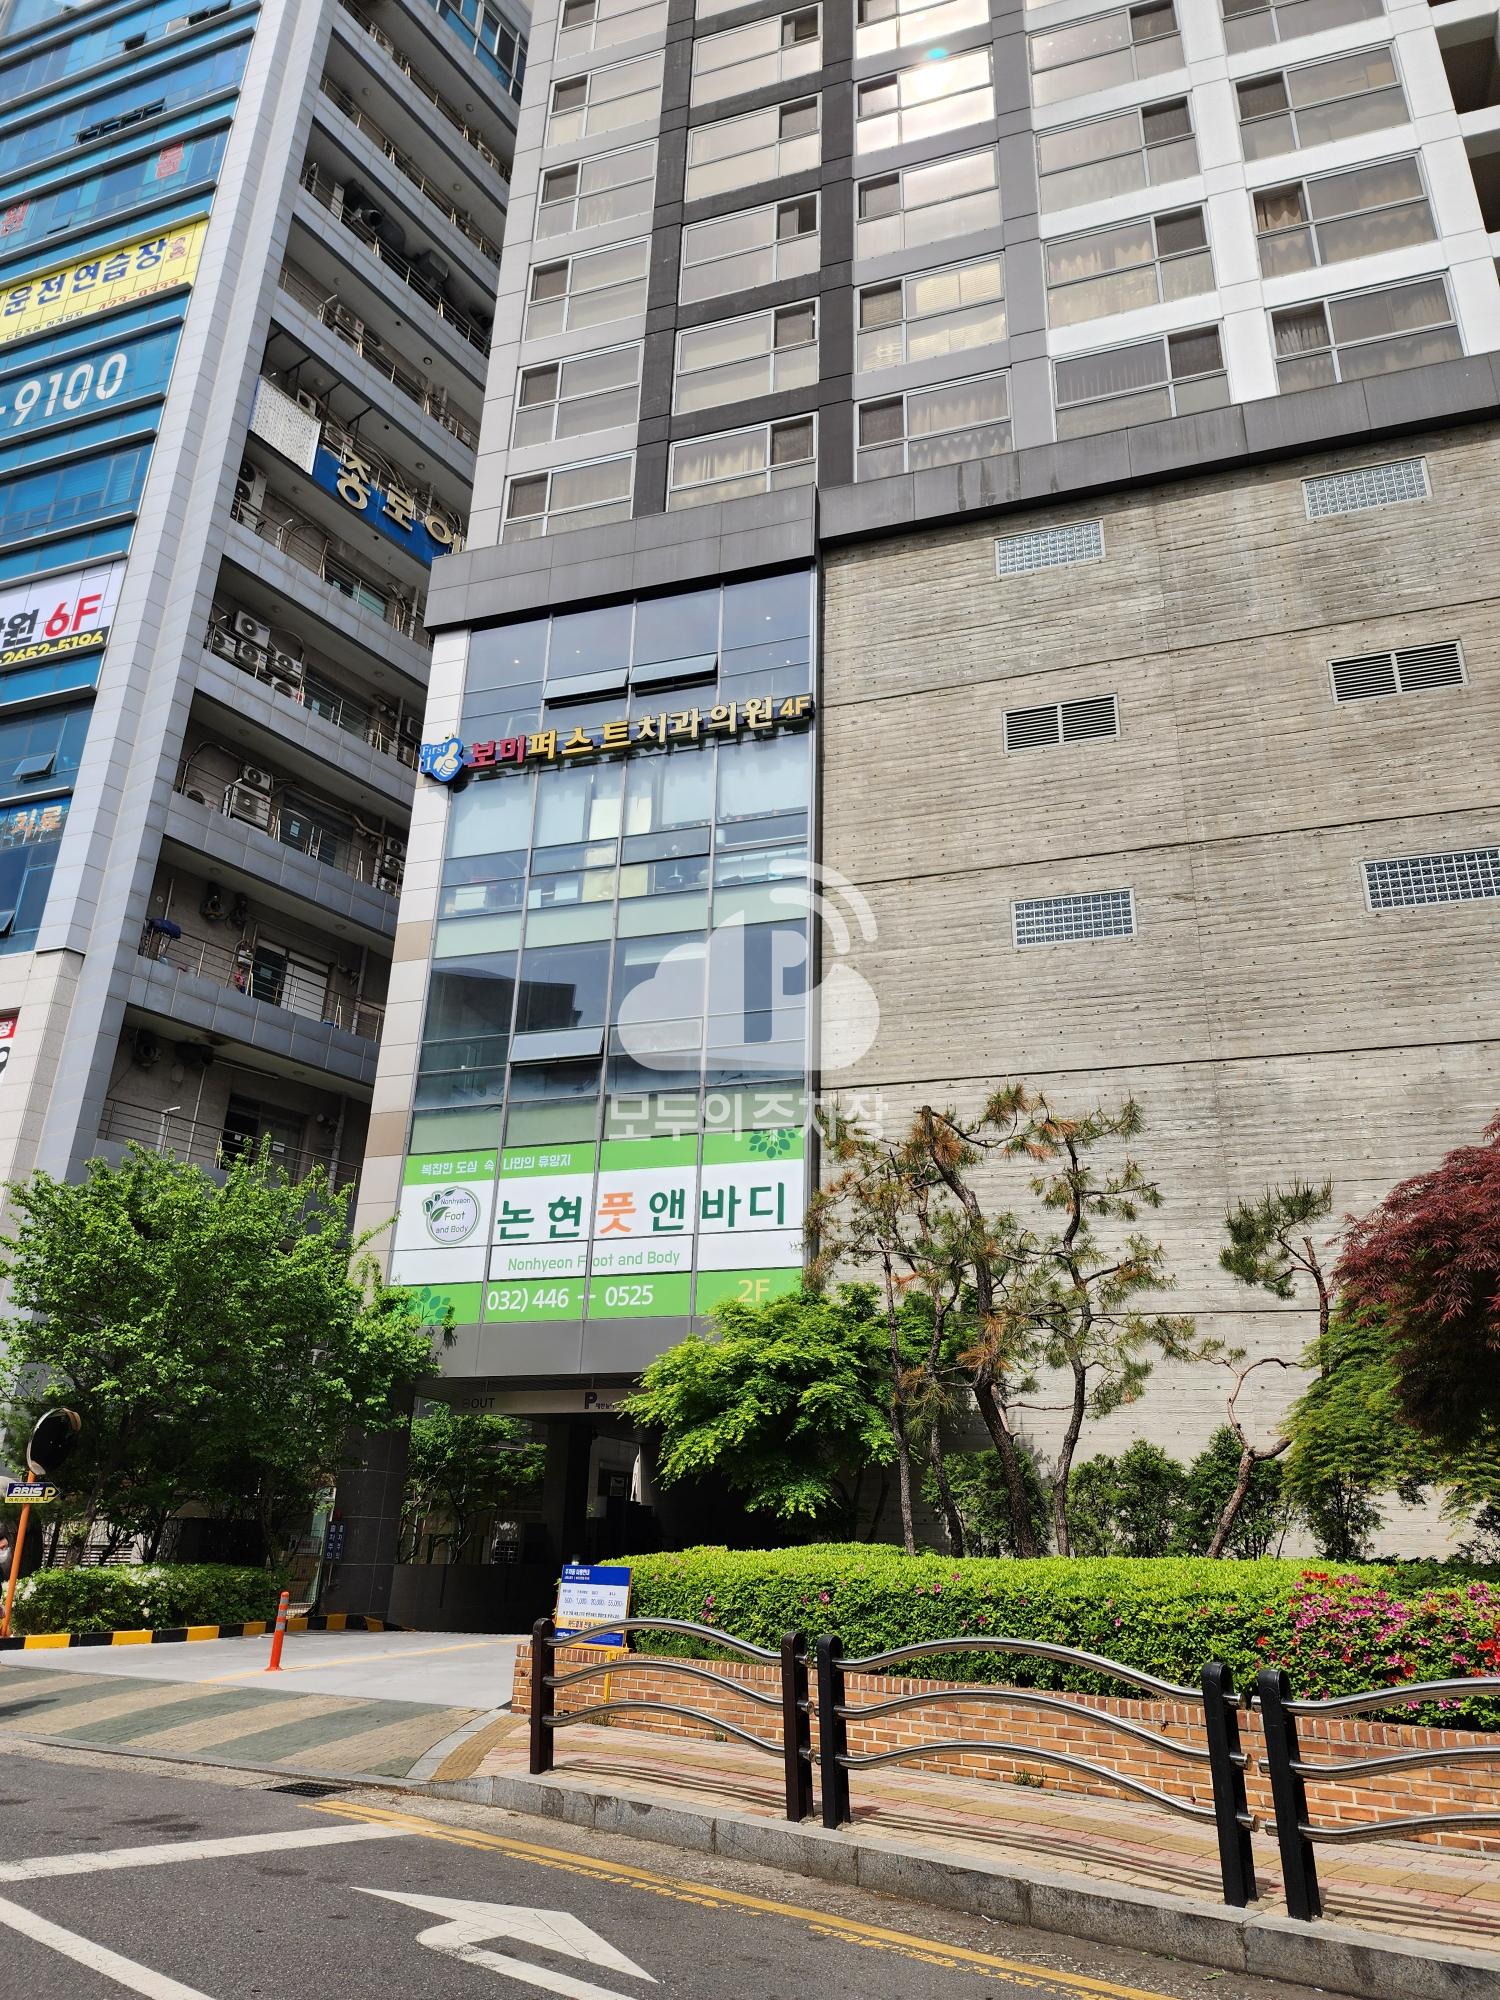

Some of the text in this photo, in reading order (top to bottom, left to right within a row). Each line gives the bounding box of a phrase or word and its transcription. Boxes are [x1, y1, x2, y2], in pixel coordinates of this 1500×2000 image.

[0, 238, 167, 317] 운전연습장
[0, 593, 103, 648] 원 6F
[467, 694, 812, 768] 보미퍼스트치과의원 4F
[422, 745, 446, 756] First
[456, 1160, 478, 1174] 도심
[503, 1156, 535, 1171] 나만의
[440, 1197, 471, 1206] Nonhyeon
[444, 1211, 465, 1221] Foot
[435, 1224, 469, 1234] and Body
[507, 1250, 680, 1272] Nonhyeon Foot and Body
[737, 1278, 771, 1304] 2F
